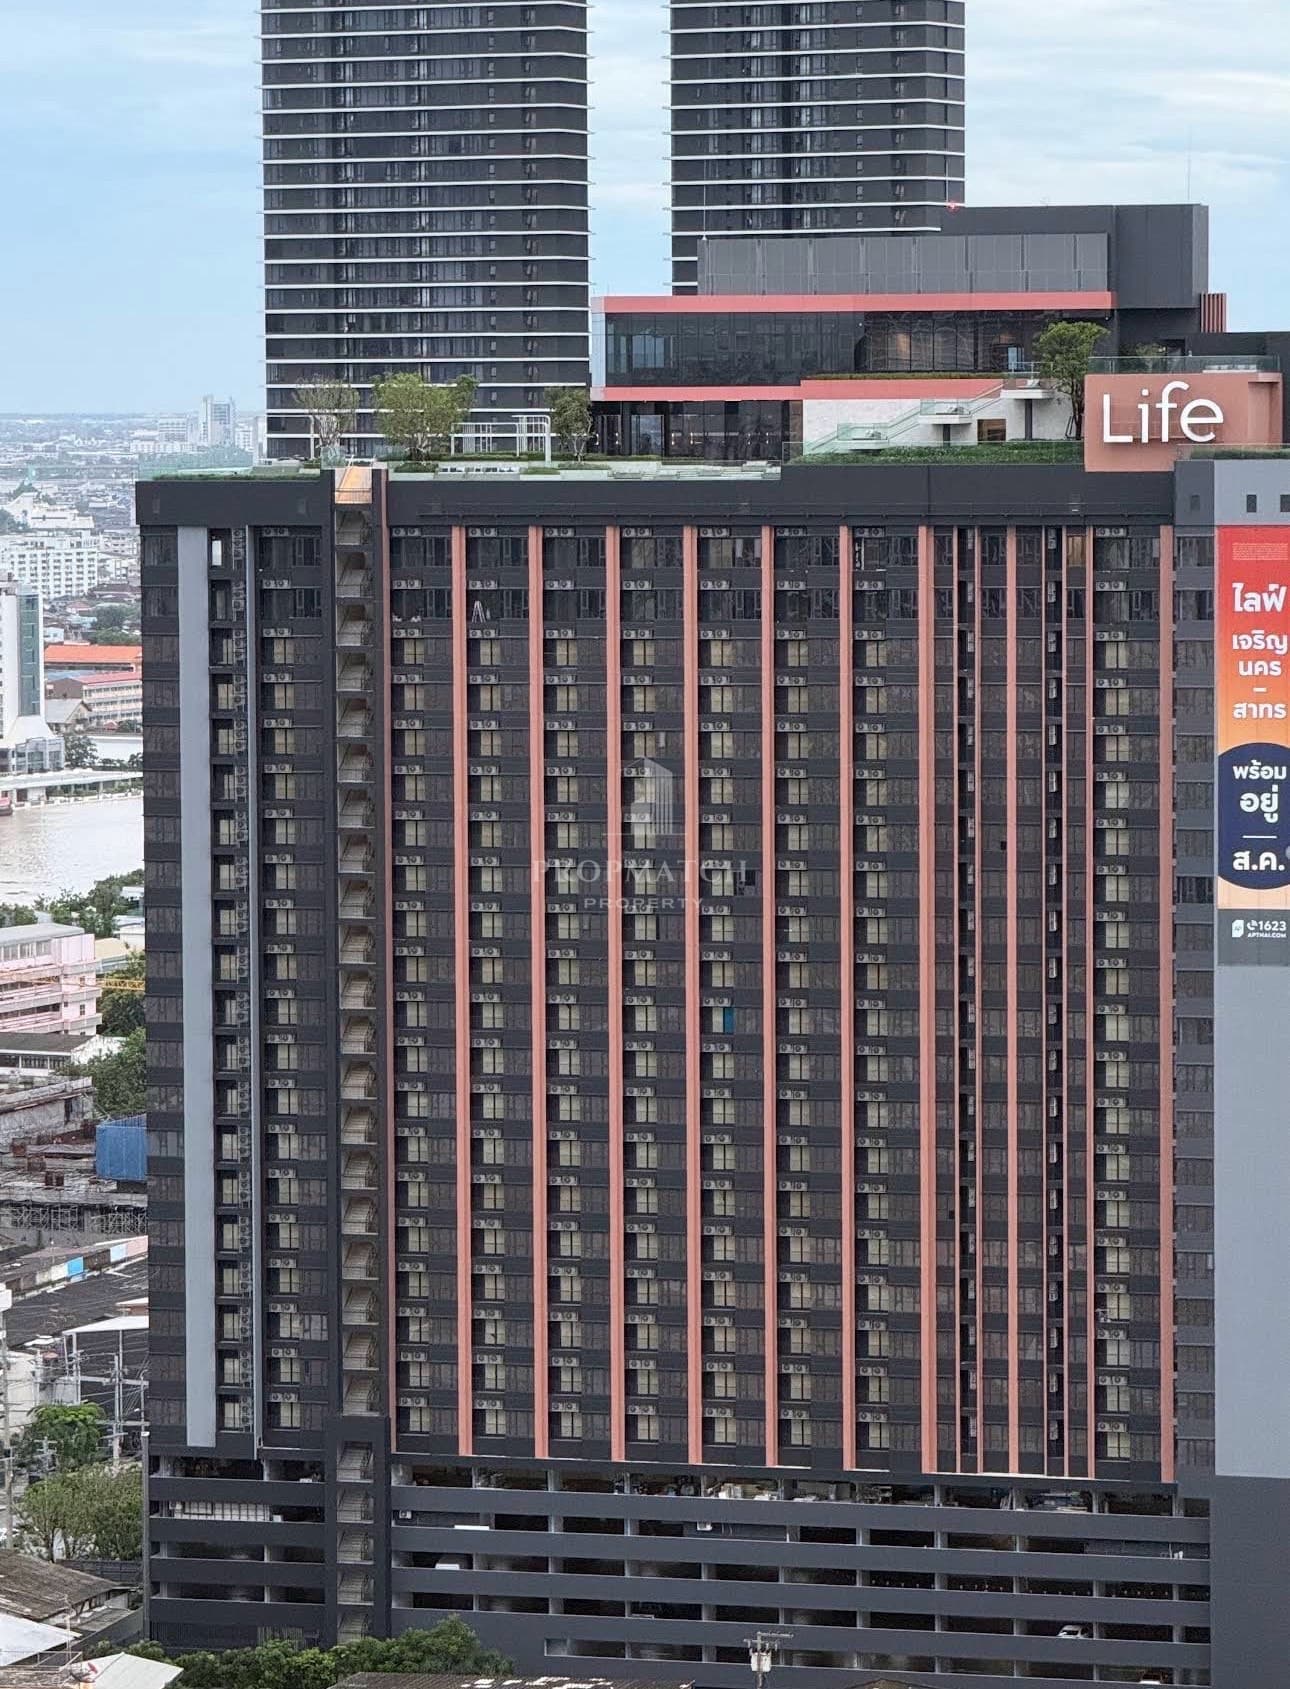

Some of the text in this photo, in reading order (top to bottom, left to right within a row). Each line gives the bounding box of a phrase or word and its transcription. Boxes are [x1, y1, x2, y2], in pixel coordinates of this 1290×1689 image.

[1103, 381, 1224, 443] Life
[1232, 629, 1288, 655] เจริญ
[1238, 660, 1282, 676] นคร
[1233, 702, 1287, 719] สาทร
[1232, 759, 1287, 780] พร้อม
[1240, 784, 1279, 823] อยู่
[1232, 850, 1285, 871] ส.ค.
[1258, 920, 1287, 931] 1623
